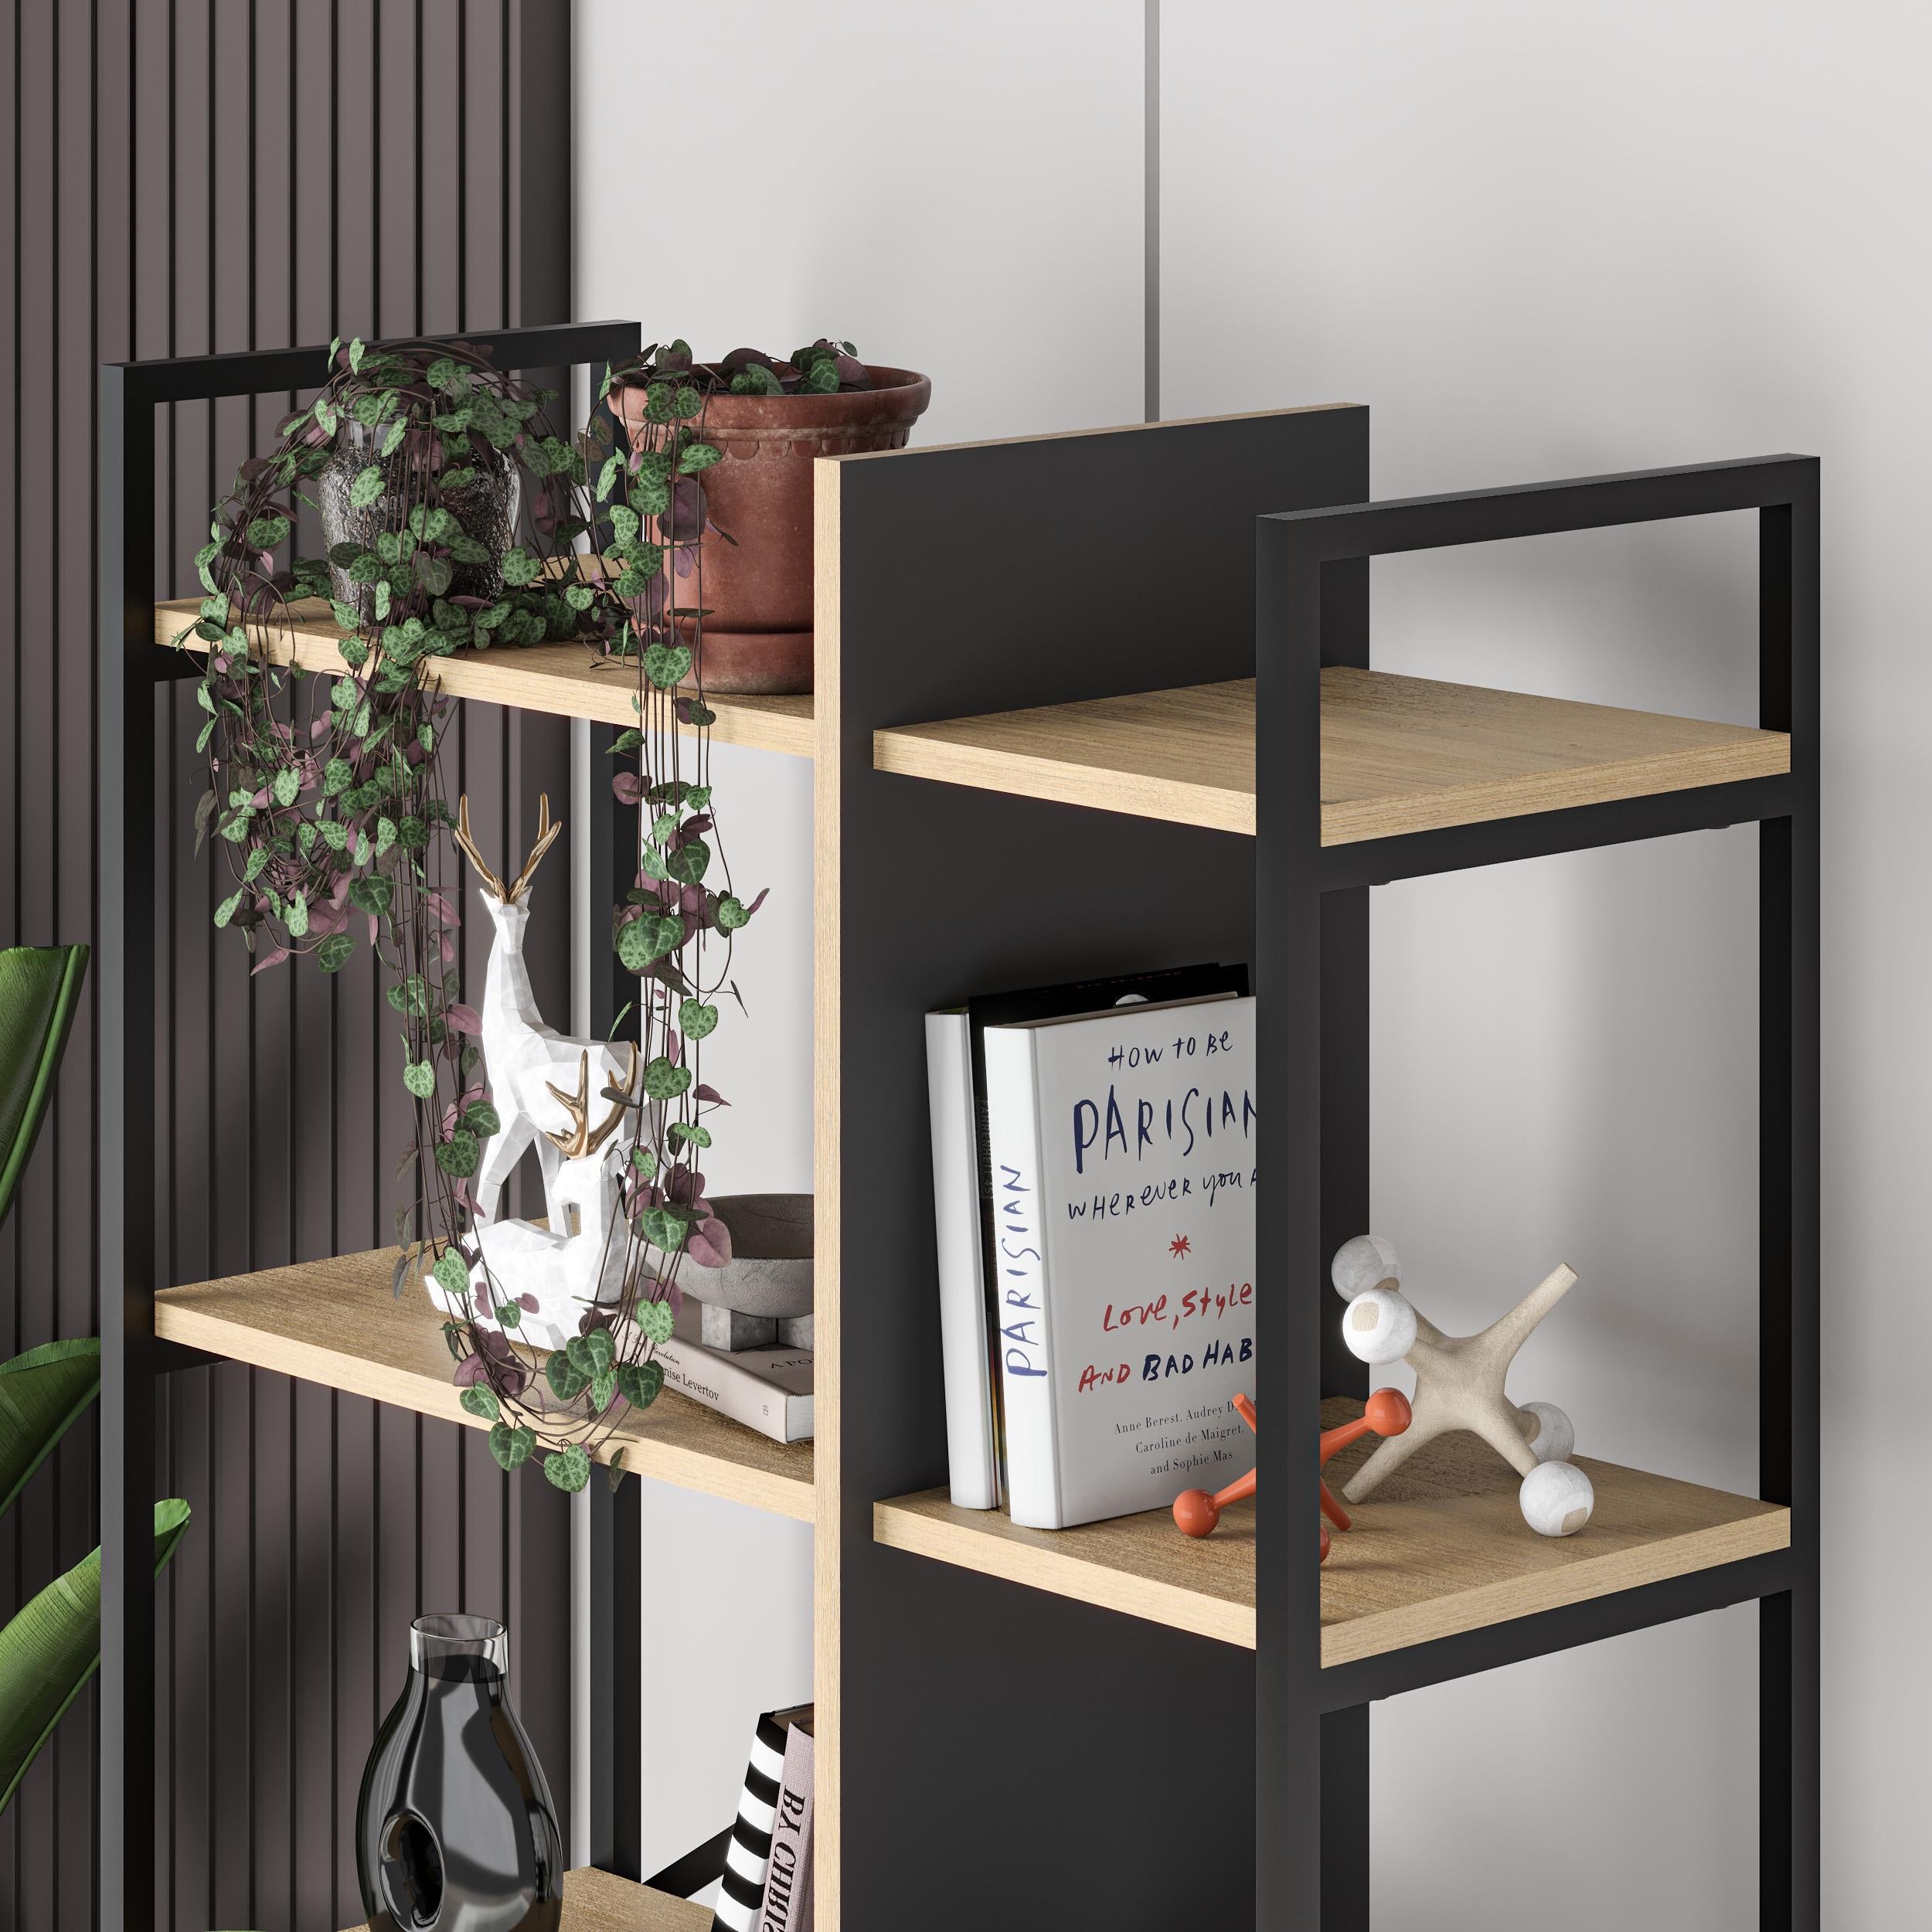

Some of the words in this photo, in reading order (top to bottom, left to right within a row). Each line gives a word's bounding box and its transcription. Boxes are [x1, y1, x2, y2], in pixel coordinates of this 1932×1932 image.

[1202, 1172, 1243, 1207] you
[1000, 1165, 1048, 1376] PARISIAN
[1078, 1364, 1131, 1393] AND
[1142, 1353, 1194, 1382] BAD
[1202, 1338, 1253, 1370] HAB
[663, 1367, 681, 1383] nise
[682, 1373, 719, 1402] Levertov
[1114, 1421, 1141, 1434] Anne
[1186, 1406, 1223, 1420] Audrey
[1136, 1437, 1182, 1454] Caroline
[1185, 1432, 1197, 1444] de
[1151, 1461, 1169, 1475] and
[1173, 1454, 1209, 1472] Sophie
[1213, 1450, 1233, 1463] Mas
